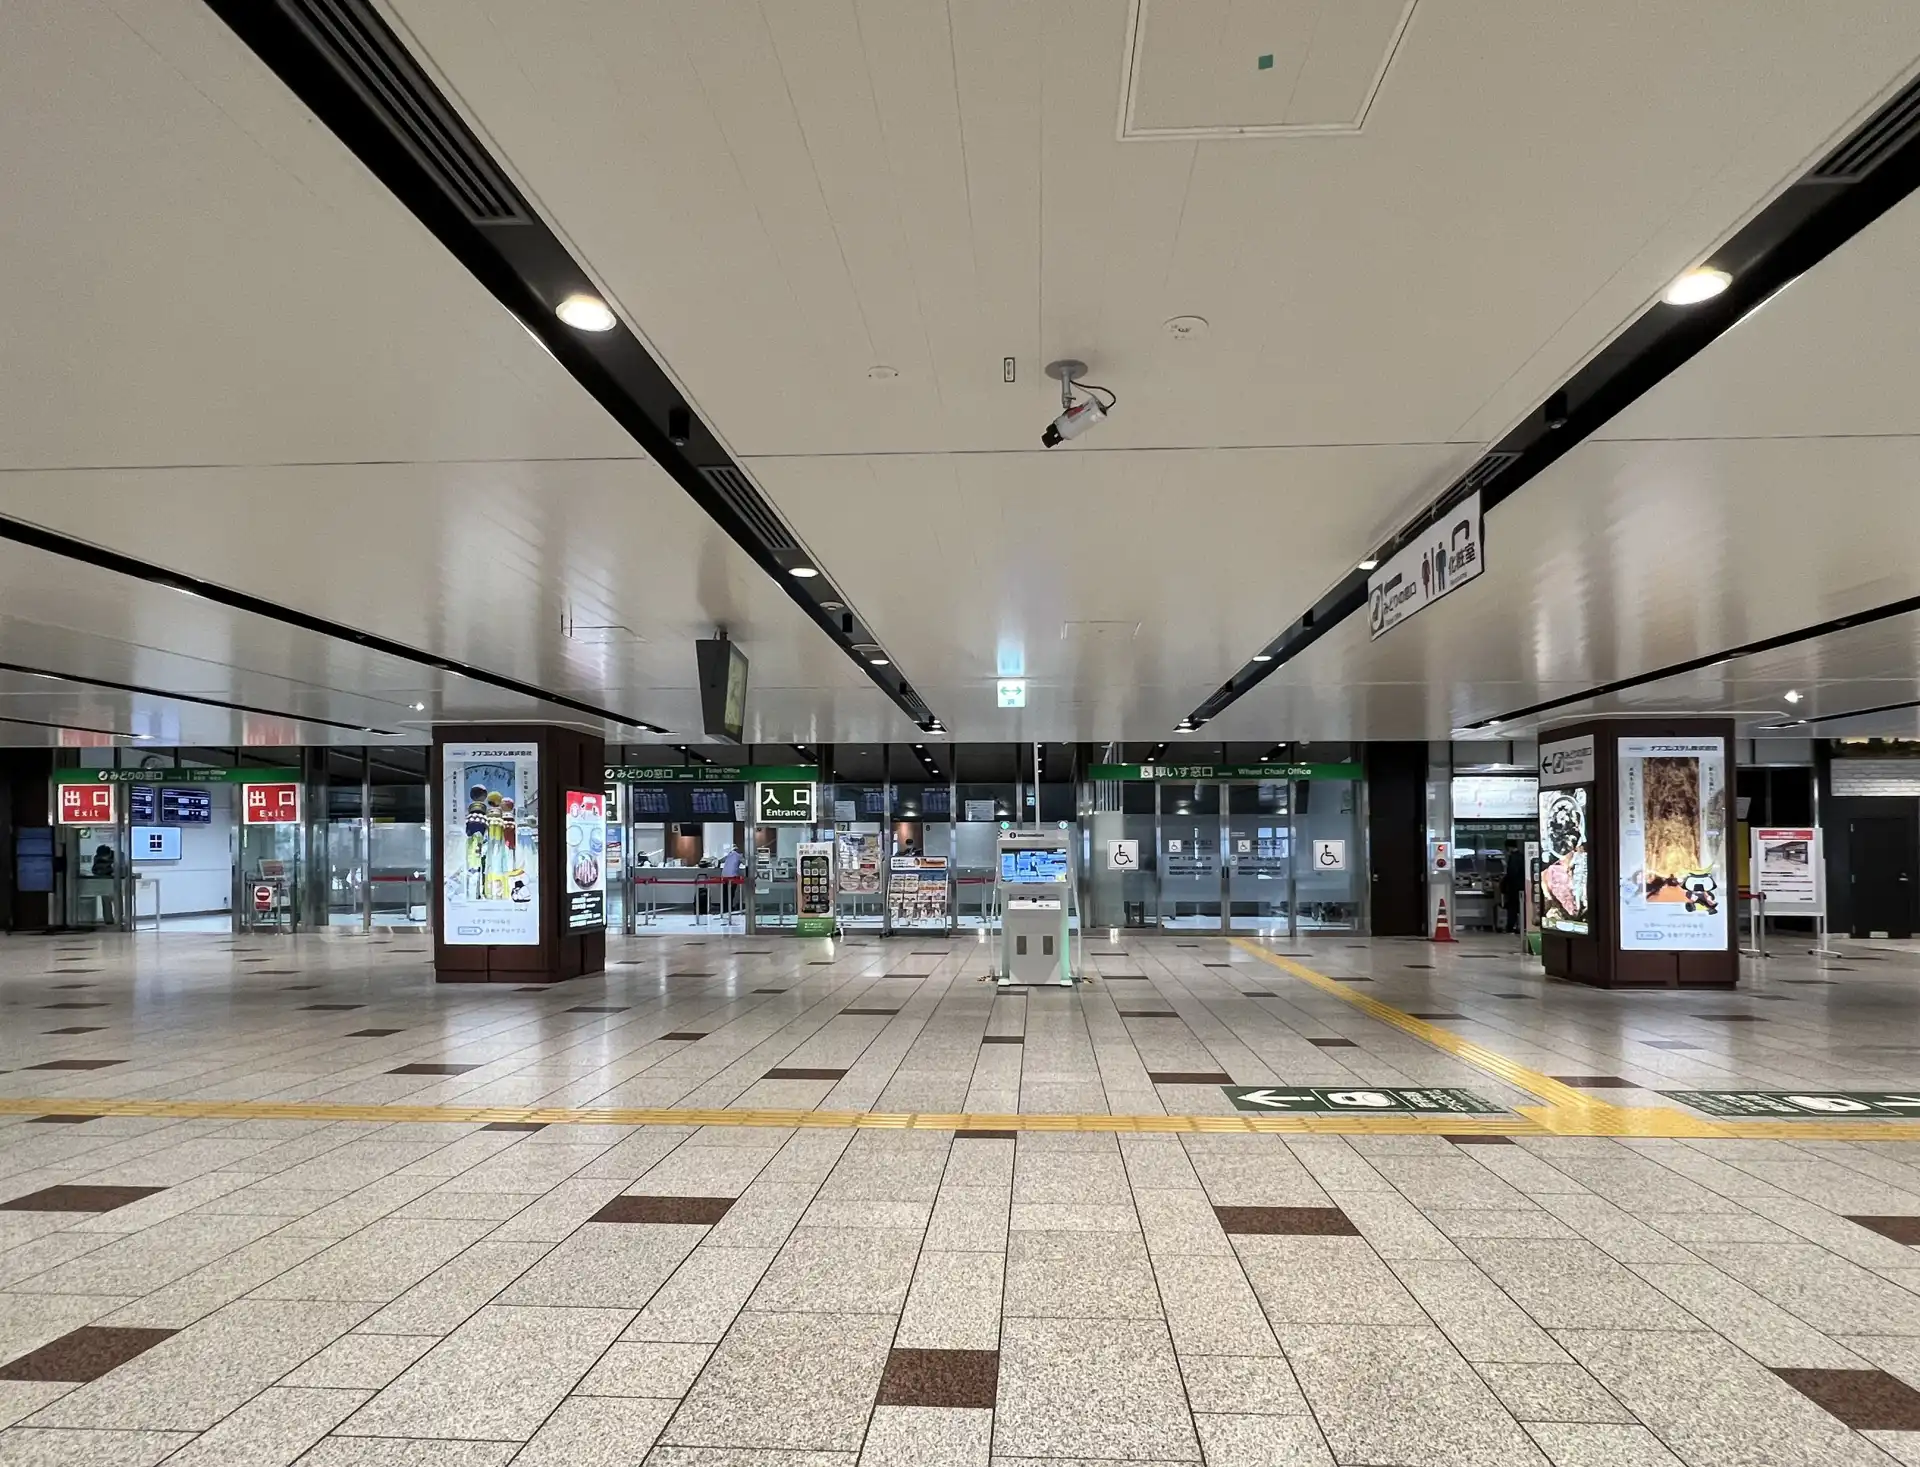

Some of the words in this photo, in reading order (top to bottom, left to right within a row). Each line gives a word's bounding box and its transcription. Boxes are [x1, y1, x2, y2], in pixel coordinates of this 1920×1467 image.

[109, 771, 163, 780] みどりの窓口
[616, 769, 673, 779] みどりの窓口
[1155, 766, 1213, 777] 車いす窓口
[1287, 767, 1312, 775] Office
[64, 790, 108, 807] 出口
[249, 790, 295, 807] 出口
[762, 789, 810, 805] 入口
[74, 809, 100, 817] Exit
[259, 809, 285, 817] Exit
[766, 809, 806, 817] Entrance
